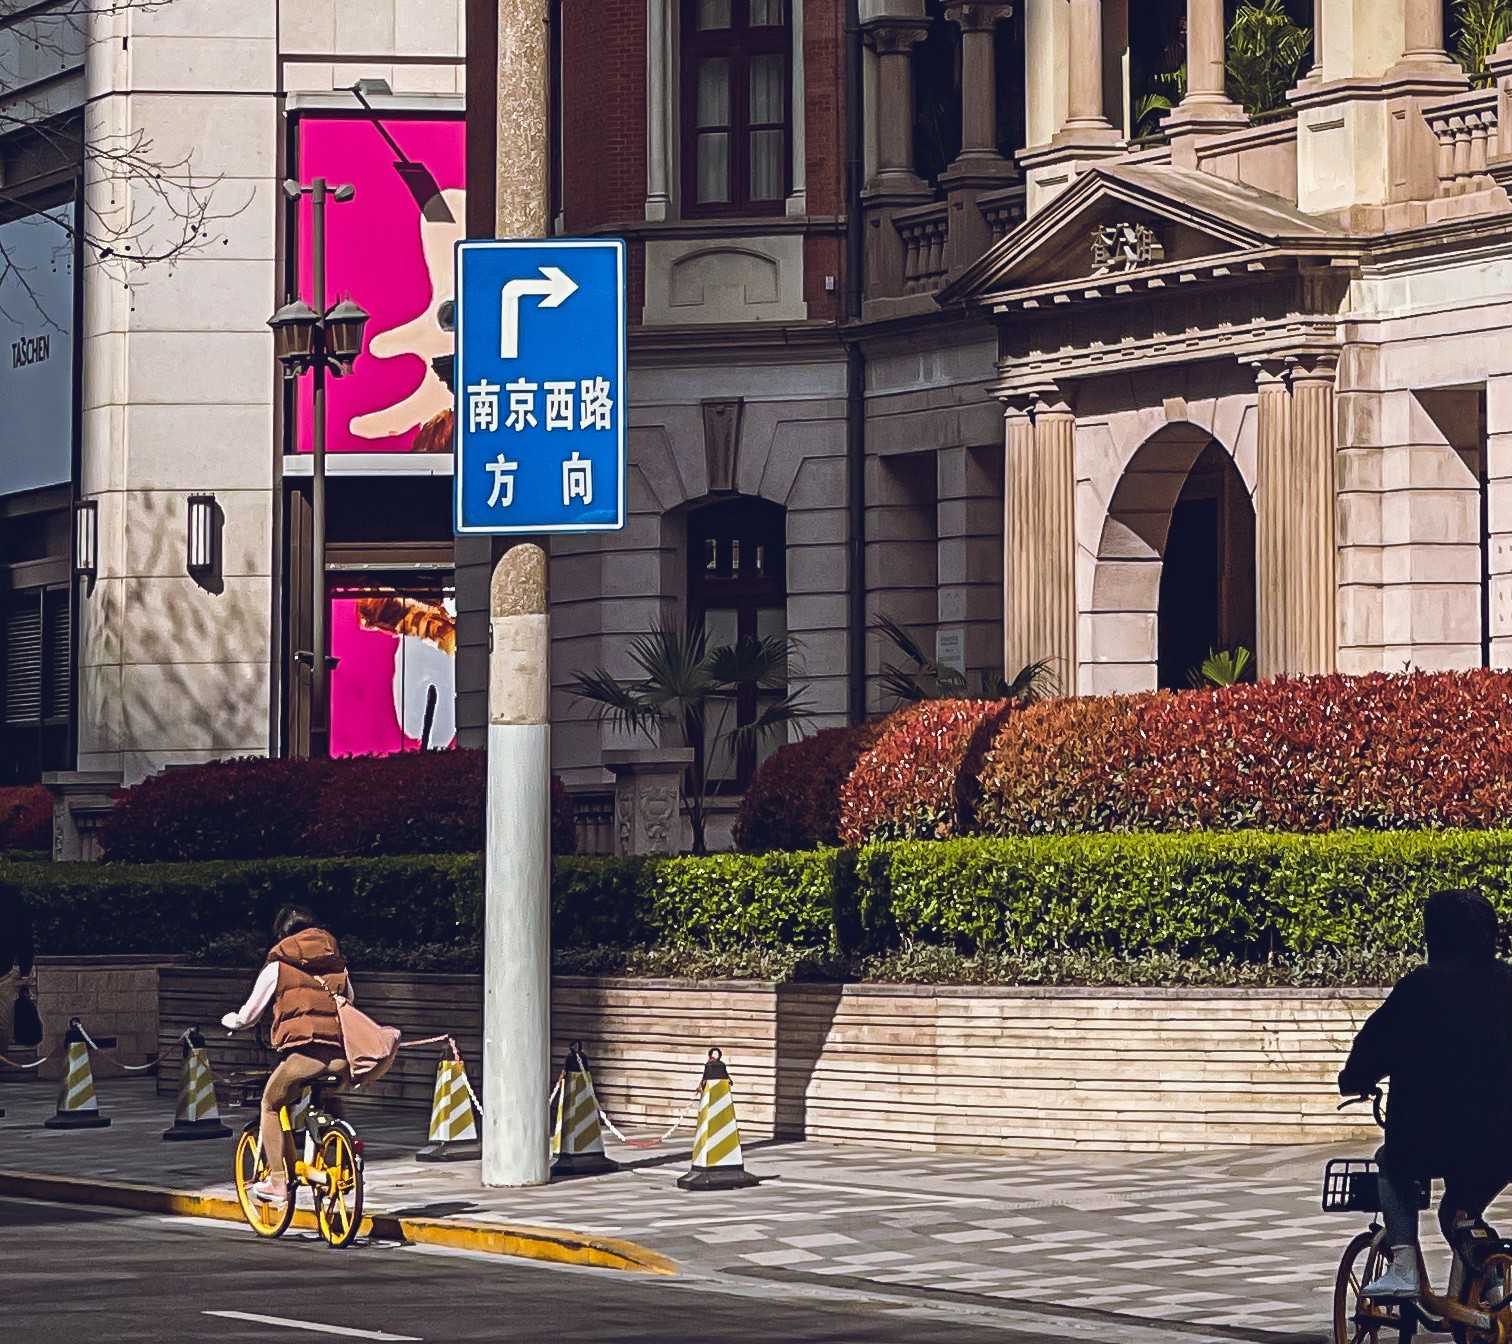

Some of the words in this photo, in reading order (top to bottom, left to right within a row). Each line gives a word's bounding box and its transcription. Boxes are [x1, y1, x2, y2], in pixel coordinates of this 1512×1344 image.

[12, 334, 50, 369] TASCHEN
[467, 376, 615, 433] 南京西路
